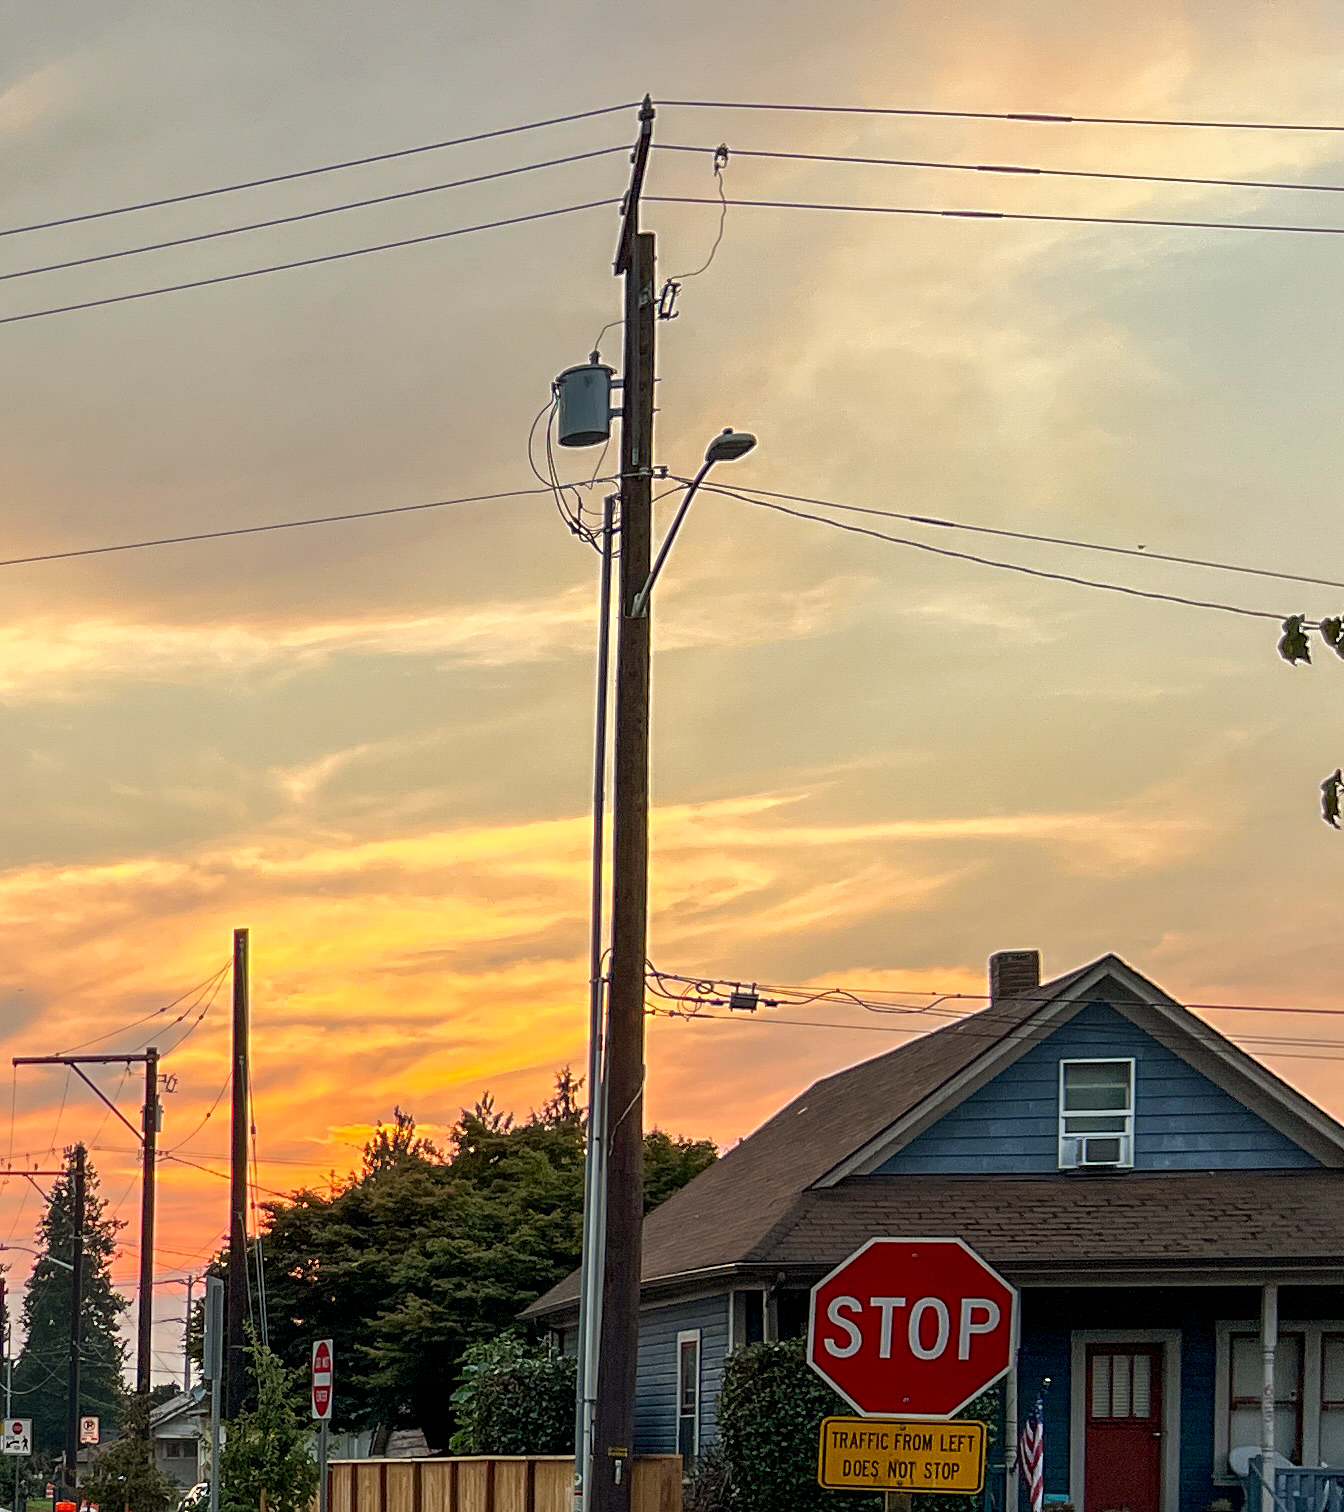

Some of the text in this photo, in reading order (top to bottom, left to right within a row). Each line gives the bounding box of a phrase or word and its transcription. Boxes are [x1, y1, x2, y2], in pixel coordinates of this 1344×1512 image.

[823, 1295, 1002, 1361] STOP
[831, 1431, 976, 1453] TRAFFIC FROM LEFT
[842, 1459, 961, 1481] DOES NOT STOP
